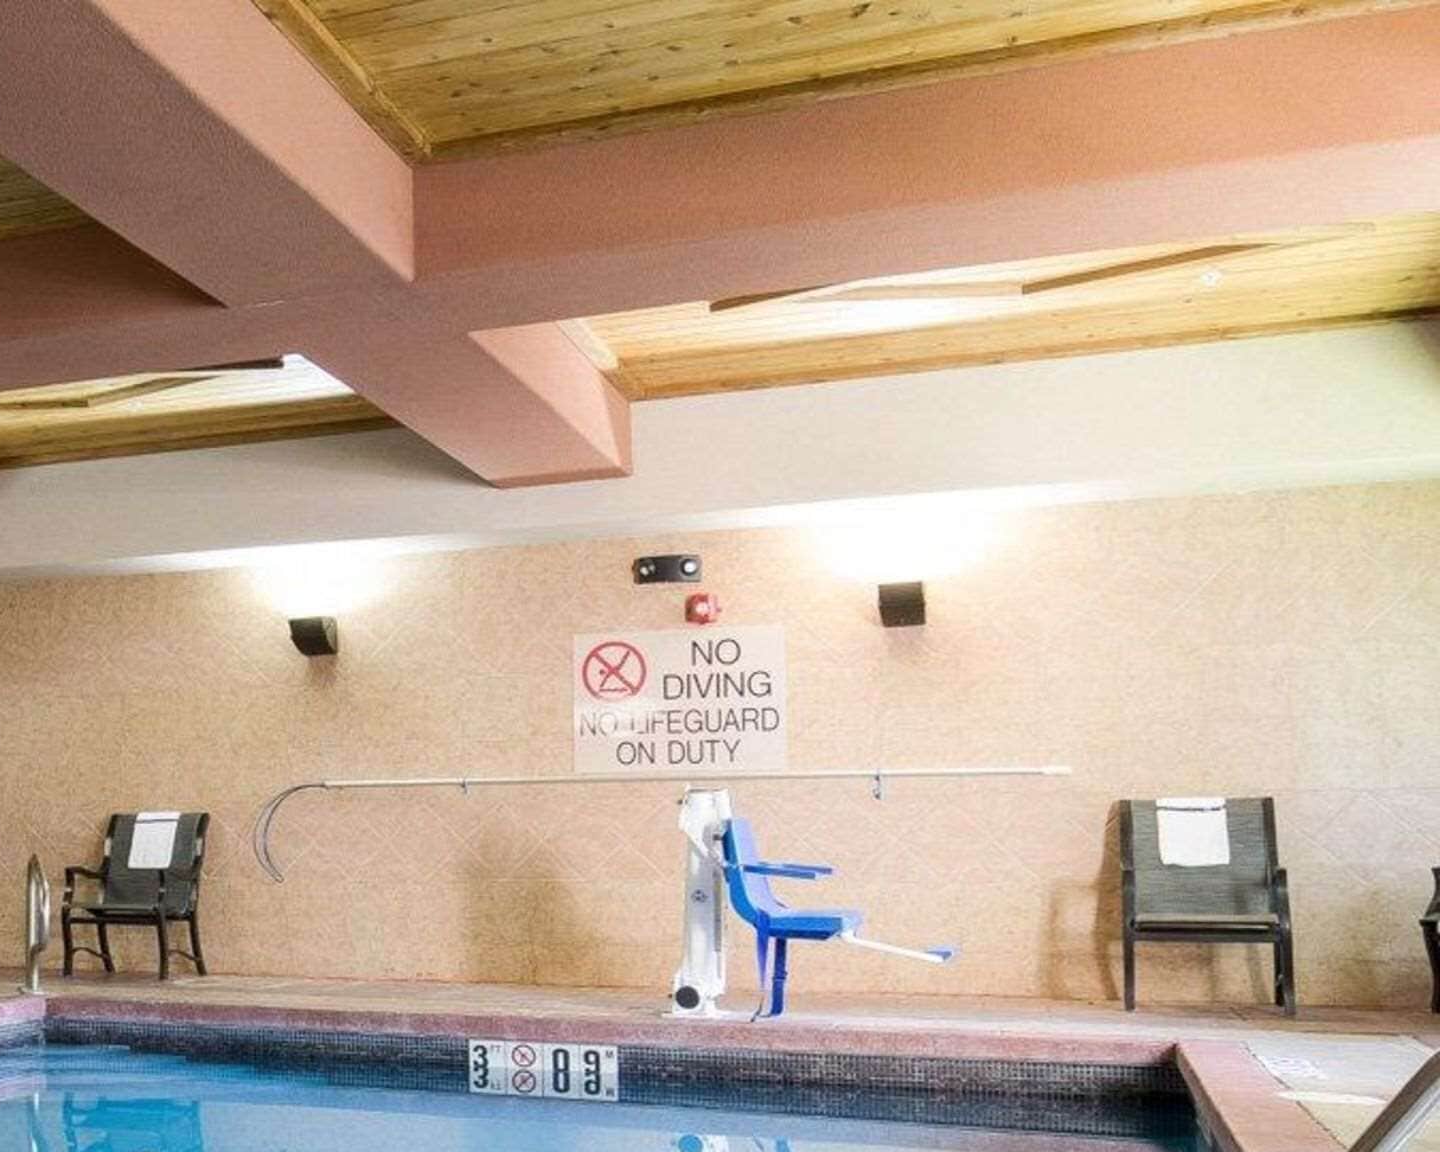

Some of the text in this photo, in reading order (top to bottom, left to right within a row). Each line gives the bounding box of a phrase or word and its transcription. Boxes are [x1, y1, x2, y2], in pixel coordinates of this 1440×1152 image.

[691, 638, 741, 667] NO
[662, 670, 772, 700] DIVING
[579, 706, 780, 737] NO LIFEGUARD
[616, 738, 742, 766] ON DUTY
